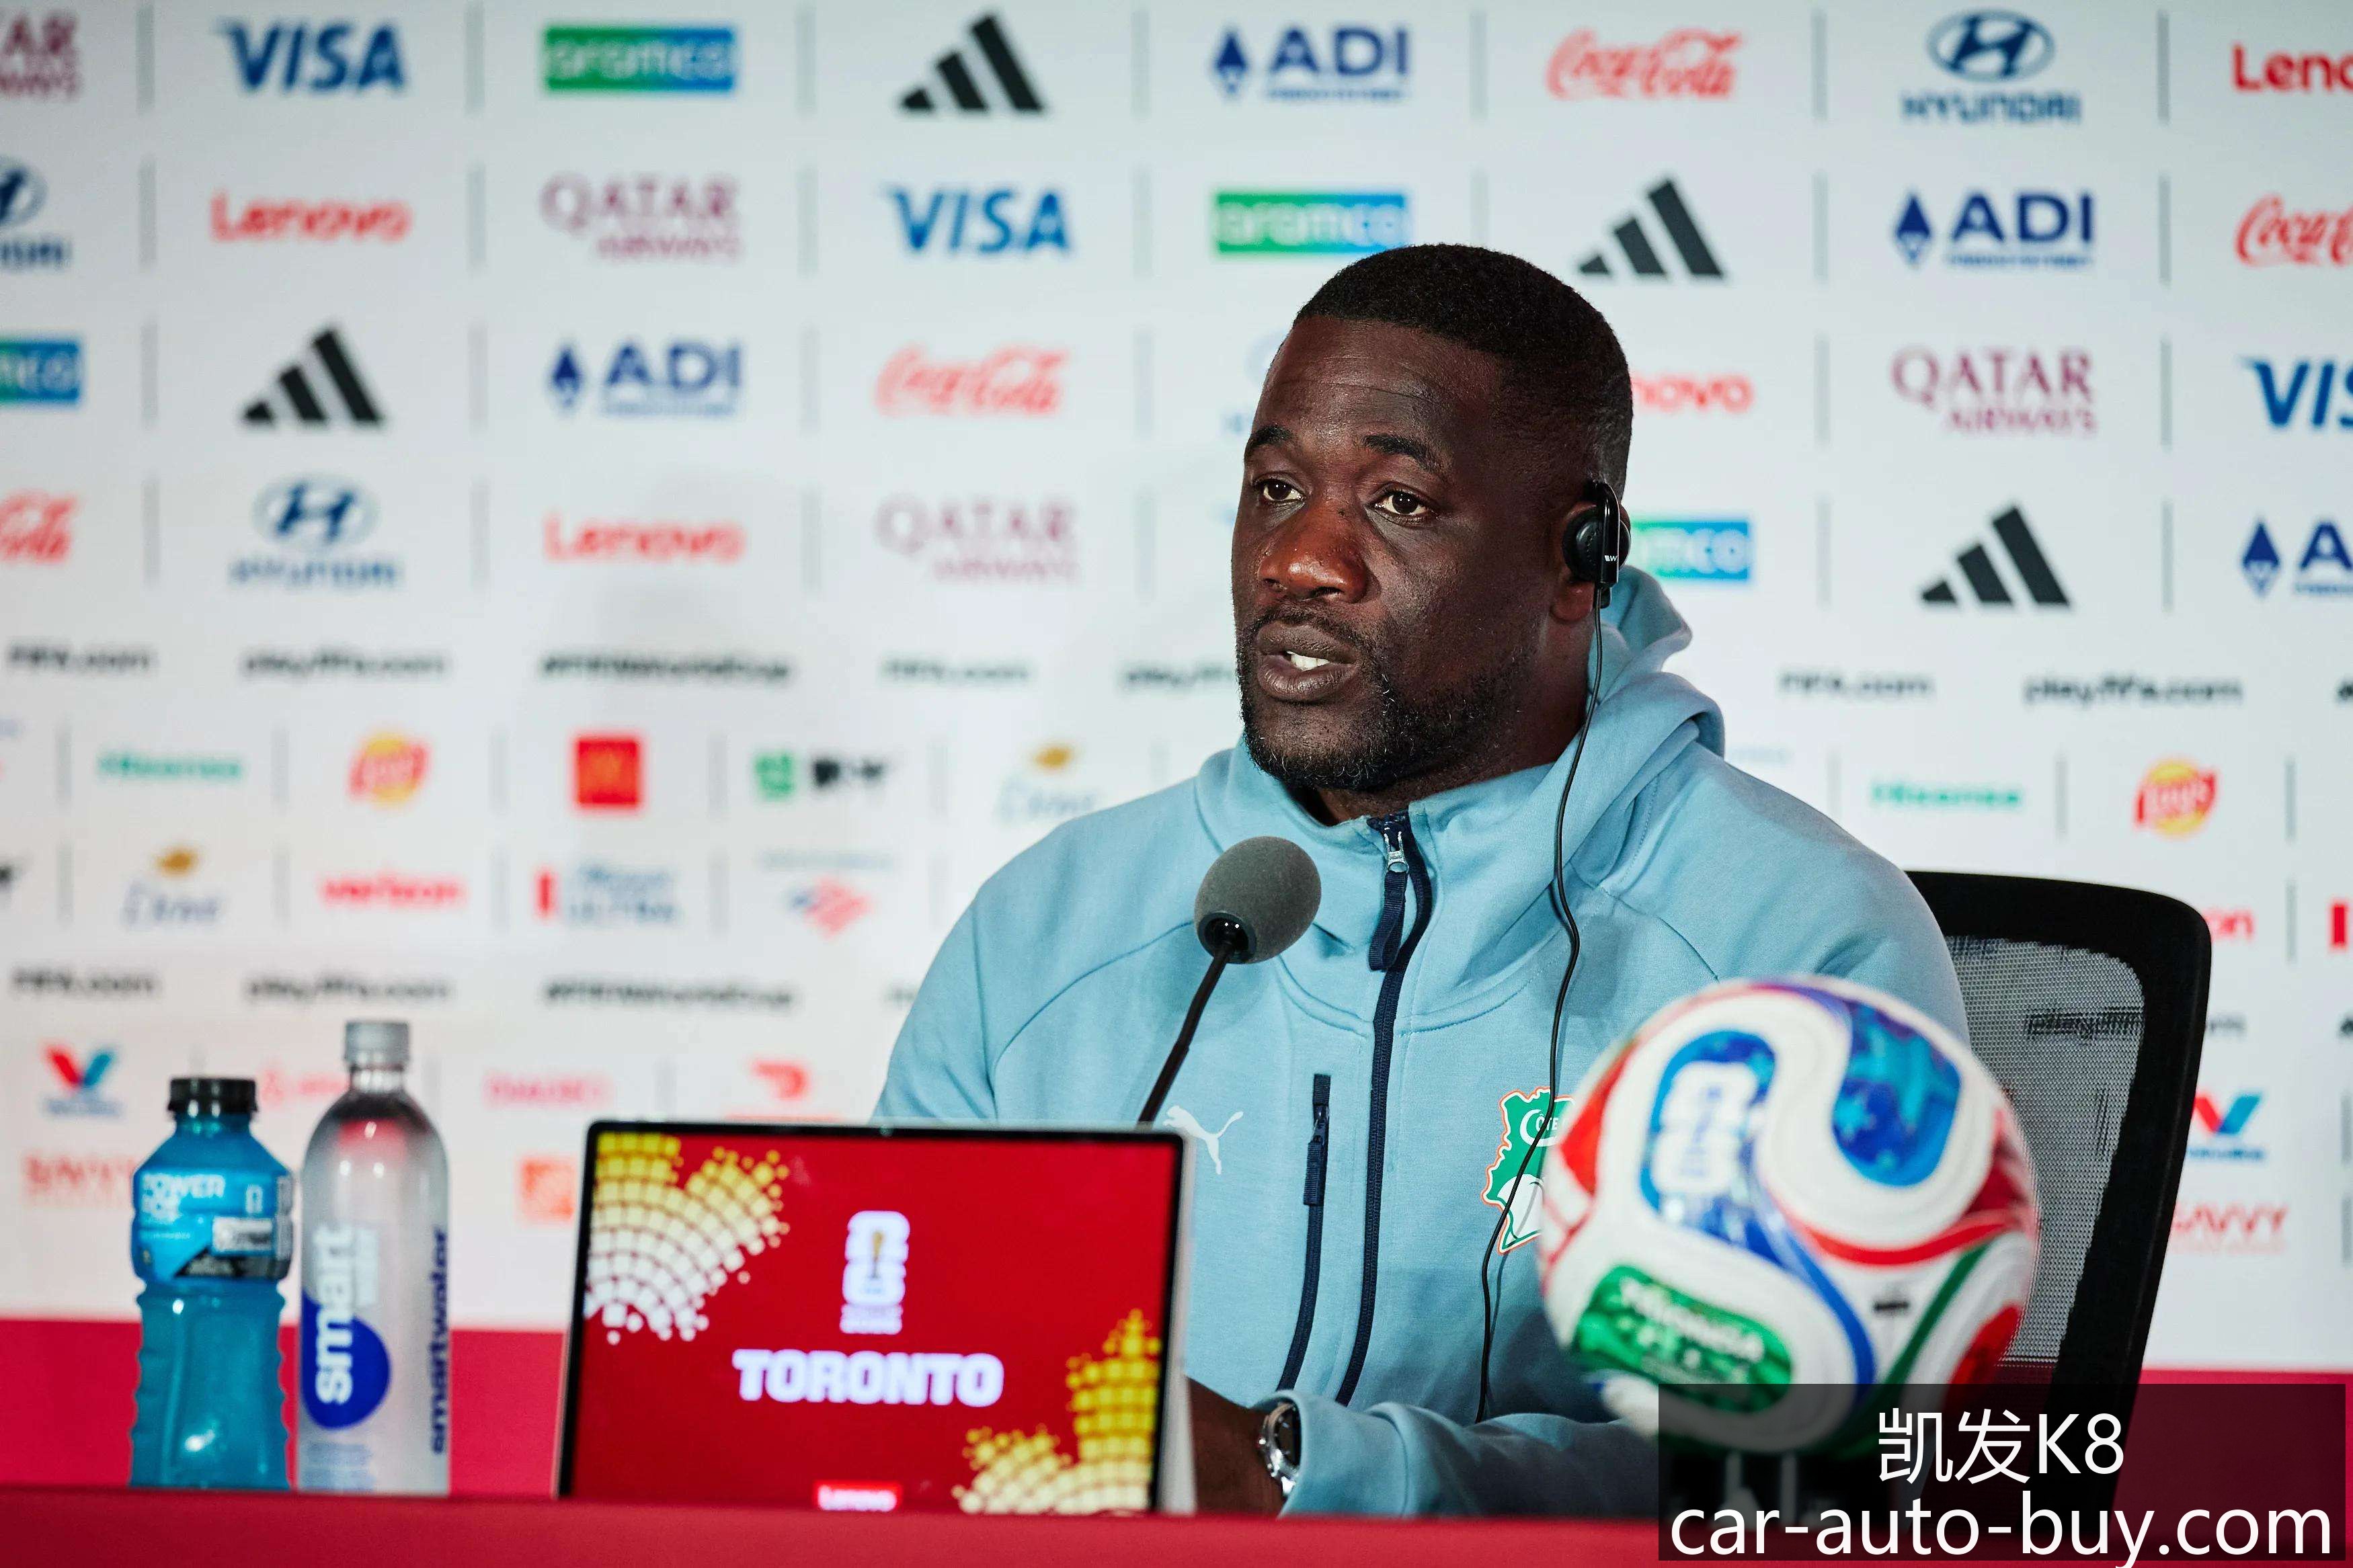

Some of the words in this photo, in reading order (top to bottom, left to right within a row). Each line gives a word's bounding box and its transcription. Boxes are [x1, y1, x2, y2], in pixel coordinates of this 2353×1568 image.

[223, 22, 406, 93] VISA
[1268, 27, 1408, 77] ADI
[211, 194, 410, 241] Lenovo
[541, 177, 735, 233] QATAR
[891, 189, 1070, 254] VISA
[1950, 192, 2093, 244] ADI
[603, 341, 740, 390] ADI
[1890, 346, 2092, 407] QATAR
[546, 514, 745, 561] Lenovo
[313, 1226, 354, 1405] smart
[731, 1348, 1004, 1407] TORONTO
